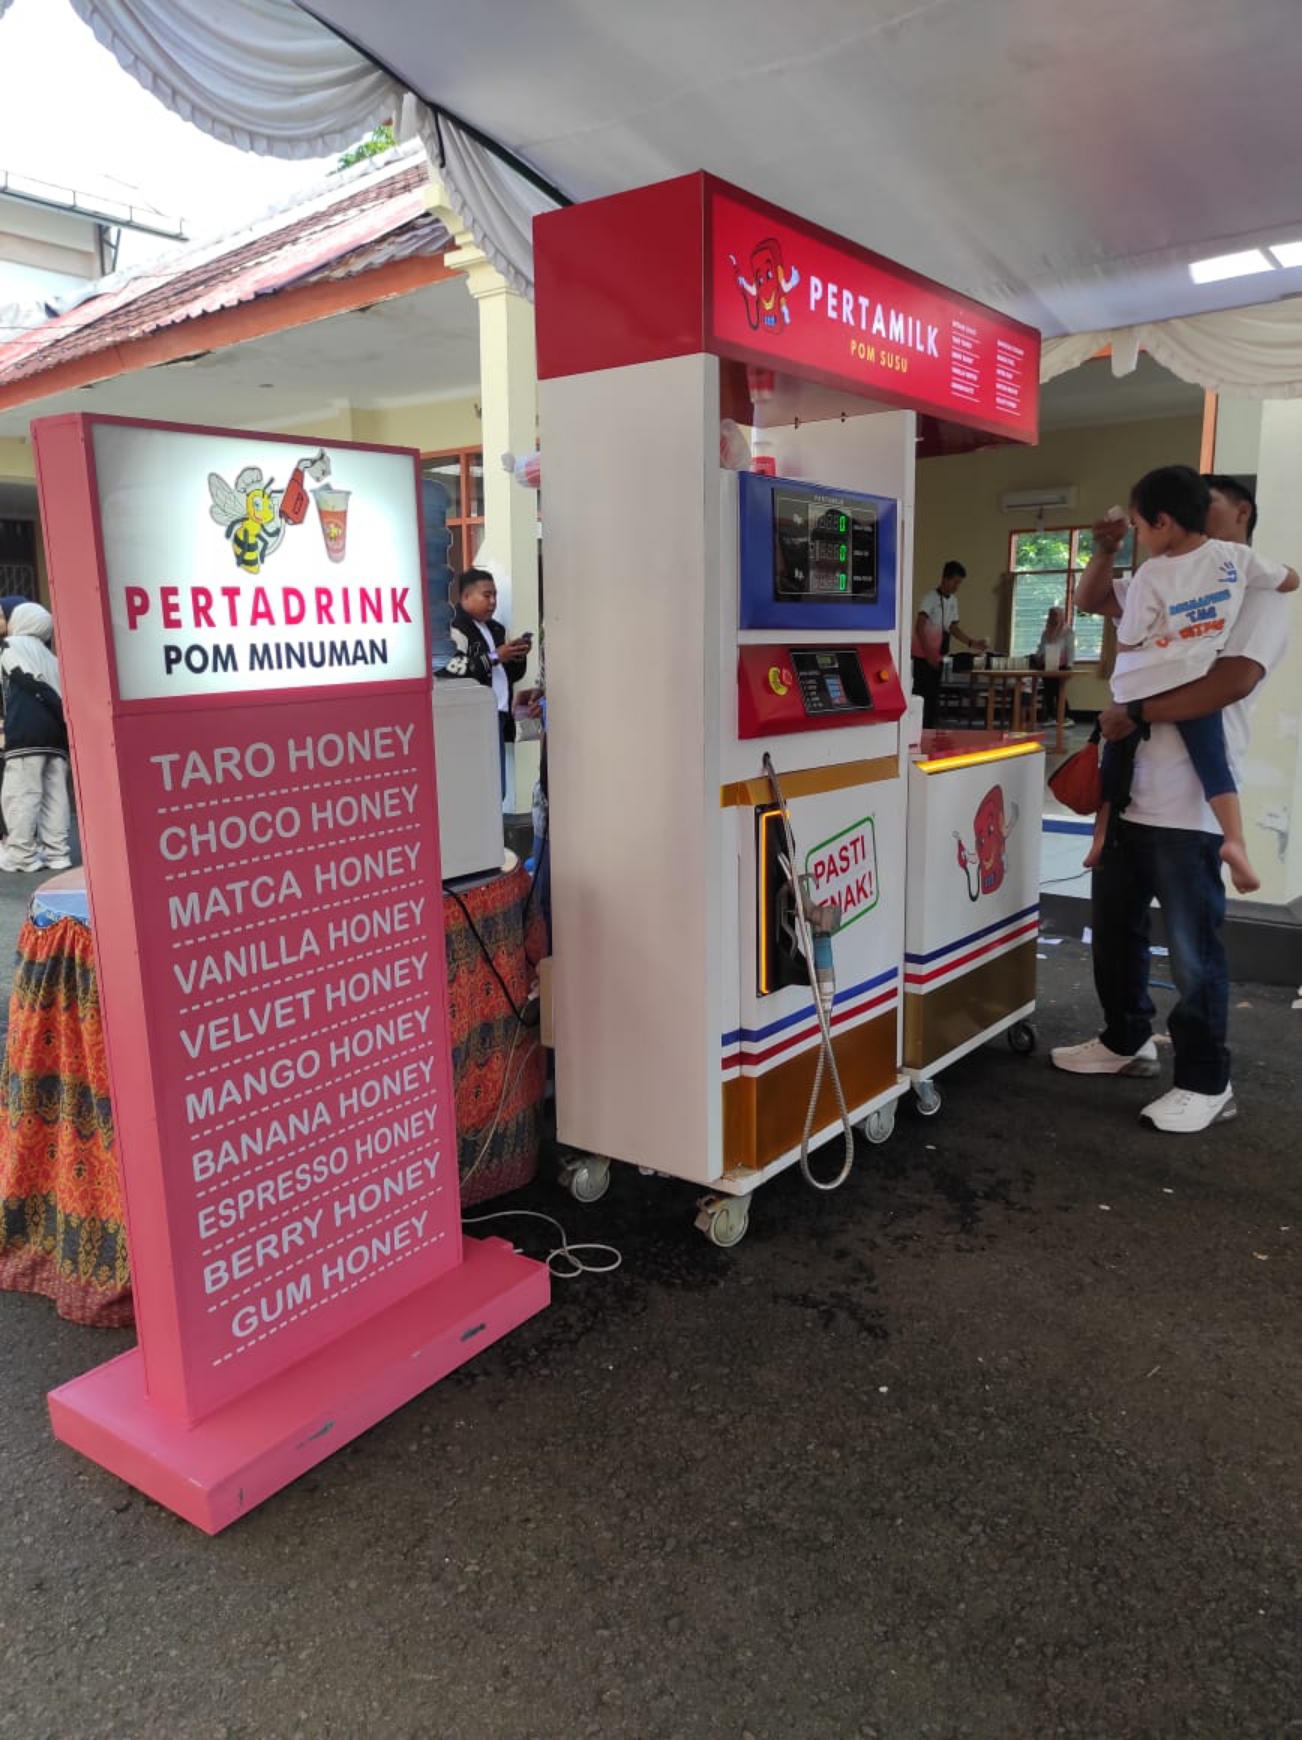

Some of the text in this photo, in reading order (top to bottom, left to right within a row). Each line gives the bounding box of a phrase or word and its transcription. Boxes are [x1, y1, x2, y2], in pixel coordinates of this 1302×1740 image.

[809, 275, 939, 358] PERTAMILK
[851, 339, 908, 373] POM SUSU
[125, 585, 413, 631] PERTADRINK
[164, 638, 389, 675] POM MINUMAN
[150, 724, 415, 793] TARO HONEY
[158, 784, 419, 862] CHOCO HONEY
[813, 835, 866, 890] PASTI
[168, 842, 421, 931] MATCA HONEY
[817, 870, 874, 914] NAK!
[173, 897, 426, 995] VANILLA HONEY
[179, 952, 429, 1059] VELVET HONEY
[186, 1006, 431, 1125] MANGO HONEY
[192, 1056, 435, 1183] BANANA HONEY
[198, 1104, 438, 1240] ESPRESSO HONEY
[203, 1152, 441, 1295] BERRY HONEY
[231, 1210, 429, 1338] GUM HONEY
